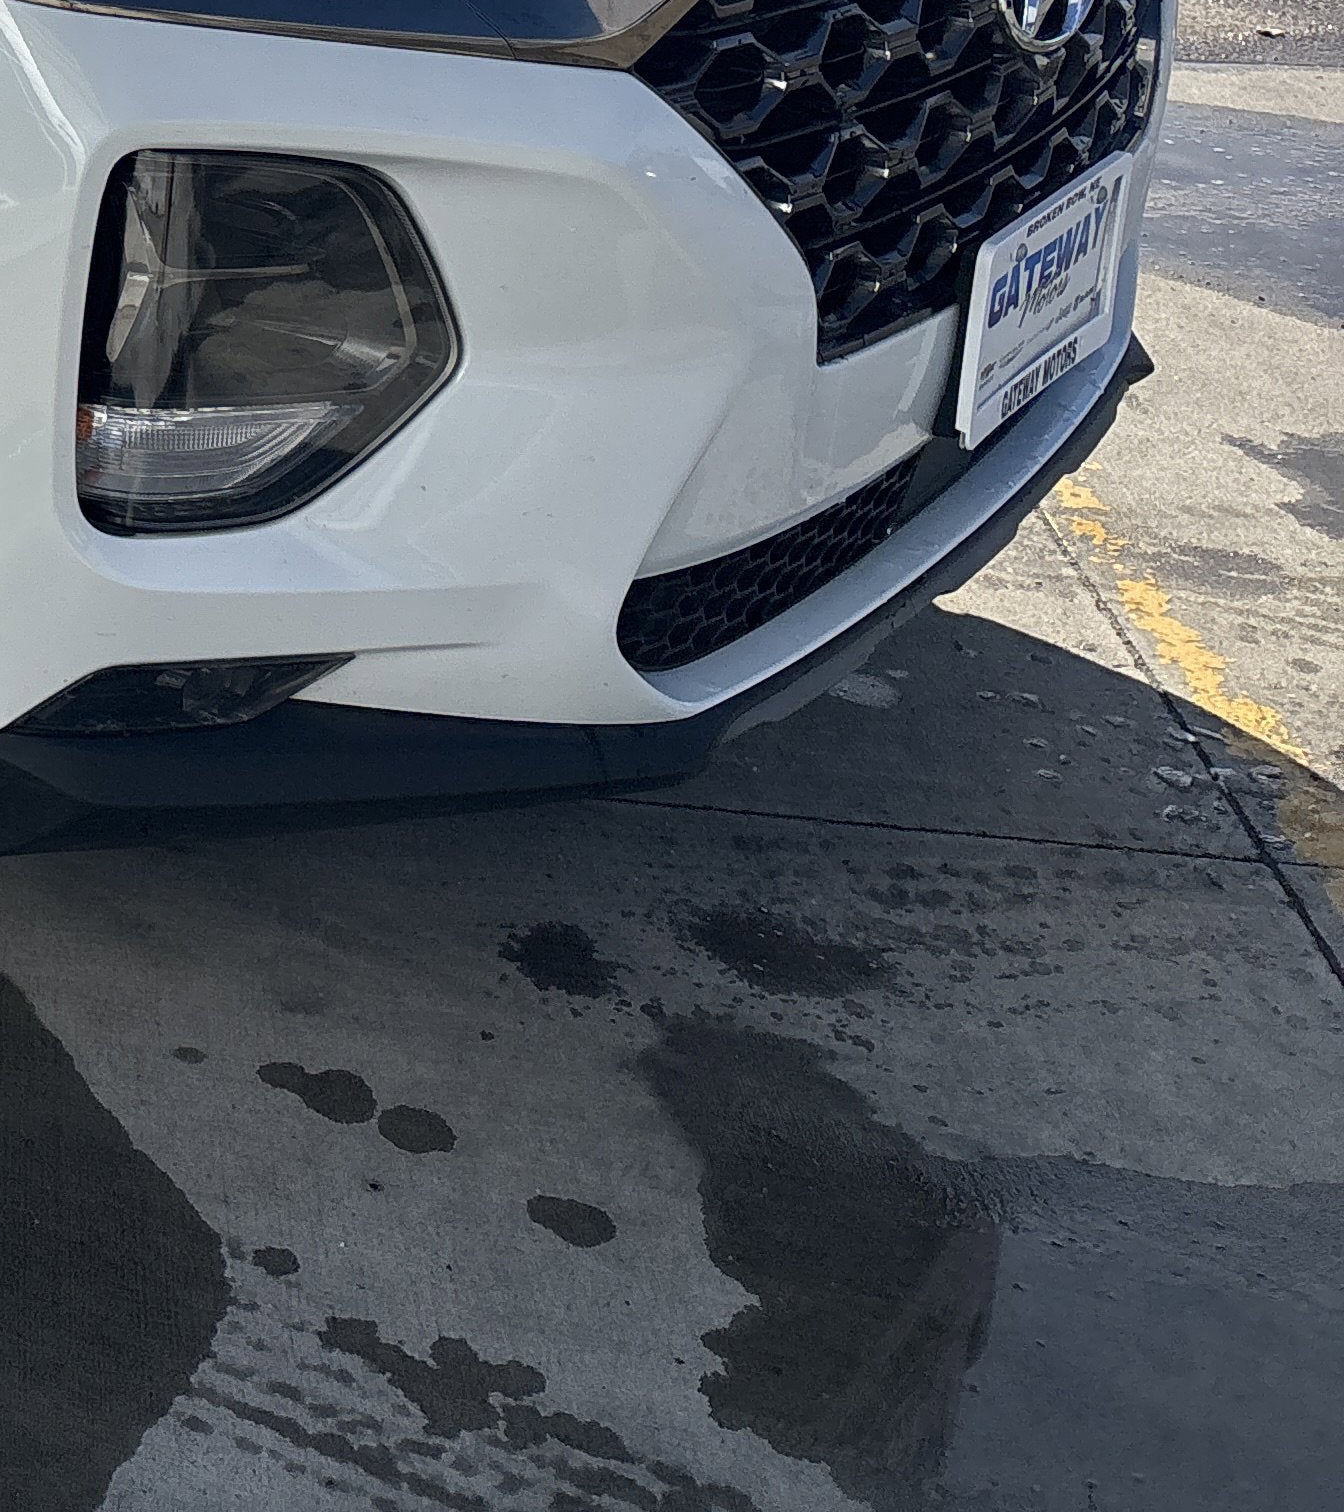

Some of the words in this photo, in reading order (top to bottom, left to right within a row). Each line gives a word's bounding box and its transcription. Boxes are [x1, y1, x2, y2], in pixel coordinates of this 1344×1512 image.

[1026, 202, 1063, 238] BROKEN
[987, 200, 1109, 329] GATEWAY
[1001, 364, 1043, 420] GATEWAY
[1041, 336, 1079, 387] MOTORS
